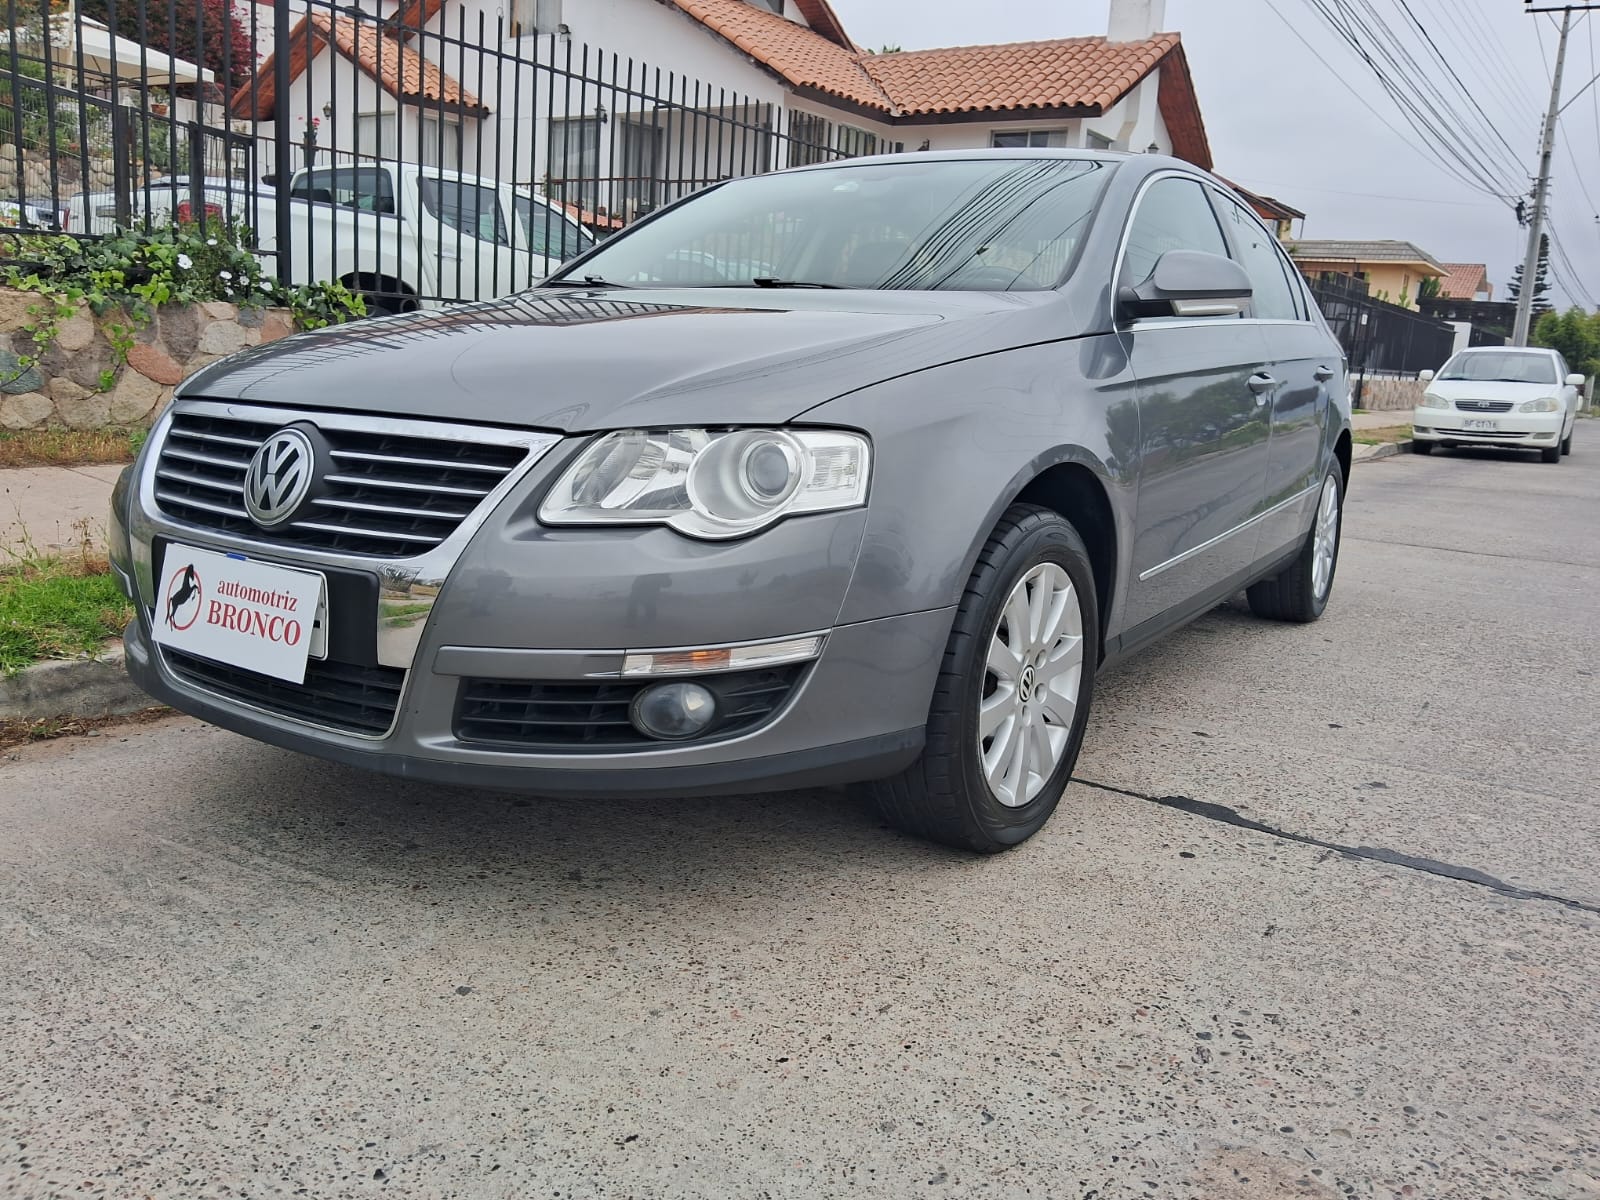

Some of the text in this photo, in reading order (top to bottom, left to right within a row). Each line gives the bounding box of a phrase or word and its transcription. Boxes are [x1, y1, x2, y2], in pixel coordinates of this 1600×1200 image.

[247, 435, 310, 515] VW
[217, 578, 298, 612] automotriz
[207, 600, 301, 646] BRONCO
